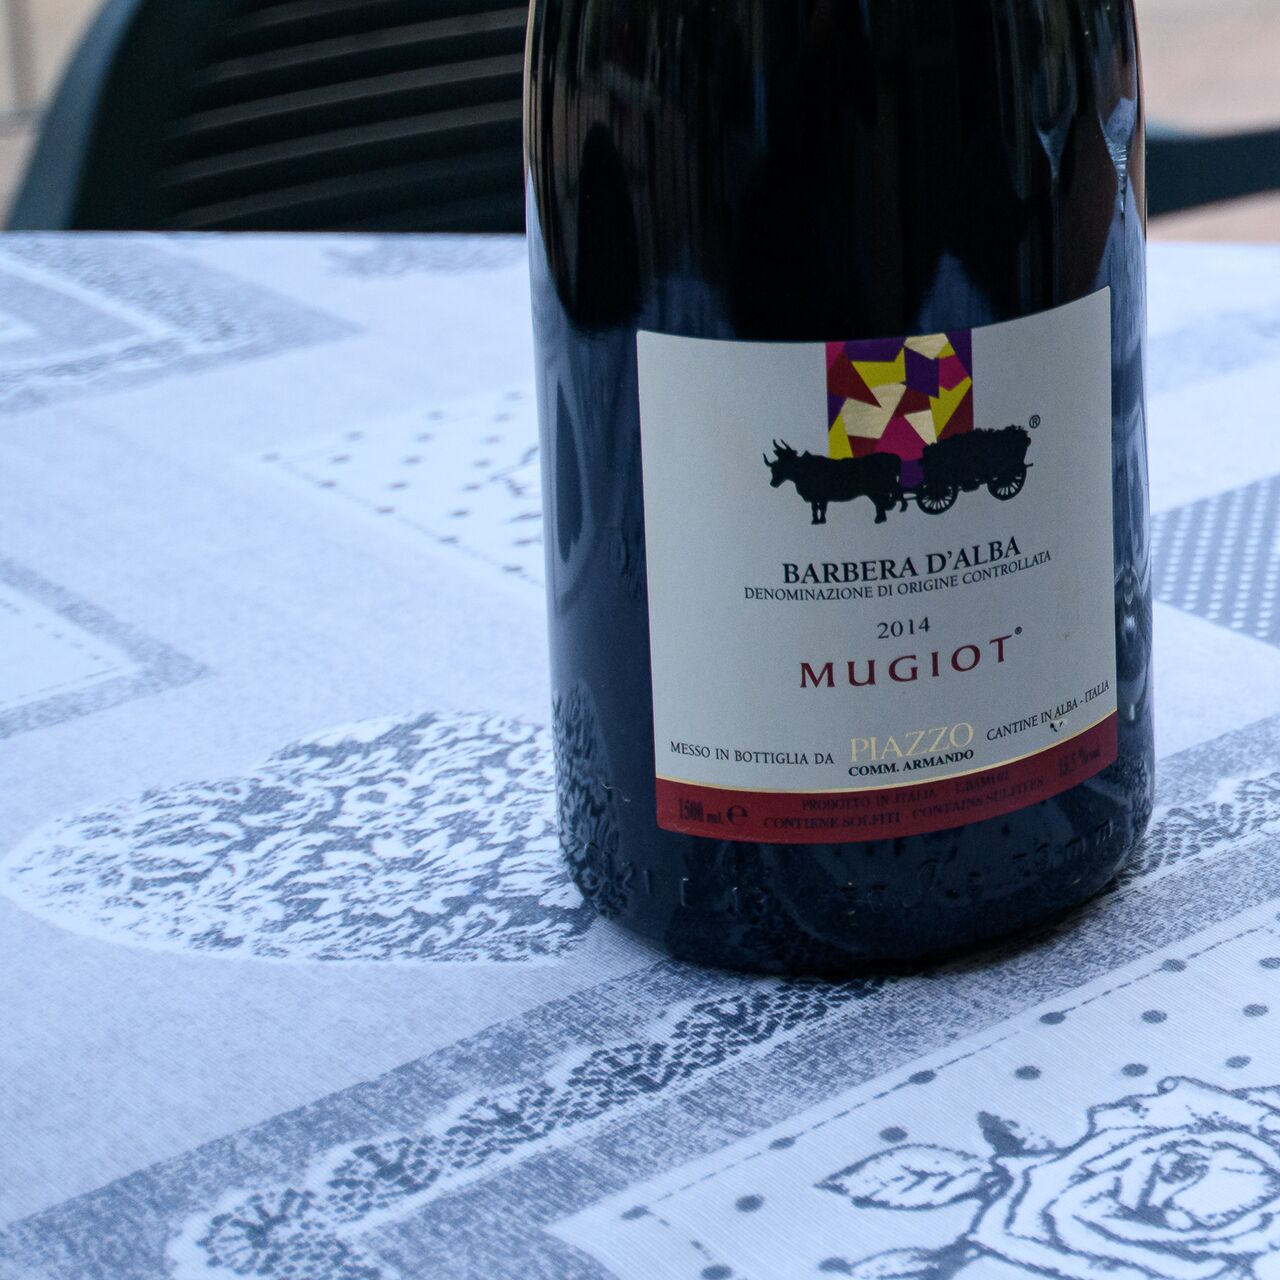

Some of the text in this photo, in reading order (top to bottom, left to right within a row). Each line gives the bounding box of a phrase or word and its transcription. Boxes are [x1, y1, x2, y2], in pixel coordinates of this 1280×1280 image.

[744, 550, 1052, 601] DENOMINAZIONE DI ORIGINE CONTROLLATA
[782, 536, 1021, 584] BARBERA D’ALBA
[877, 617, 931, 639] 2014
[986, 715, 1039, 741] CANTINE
[1040, 709, 1052, 723] IN
[1054, 698, 1078, 719] ALBA
[1084, 679, 1110, 703] ITALIA
[670, 741, 834, 765] MESSO IN BOTTIGLIA DA
[850, 722, 974, 762] PIAZZO
[848, 749, 974, 777] COMM. ARMANDO
[763, 815, 836, 829] CONTIENE
[912, 797, 983, 819] CONTAINS
[801, 792, 870, 811] PRODOTTO
[874, 791, 889, 806] IN
[894, 788, 936, 804] ITALIA
